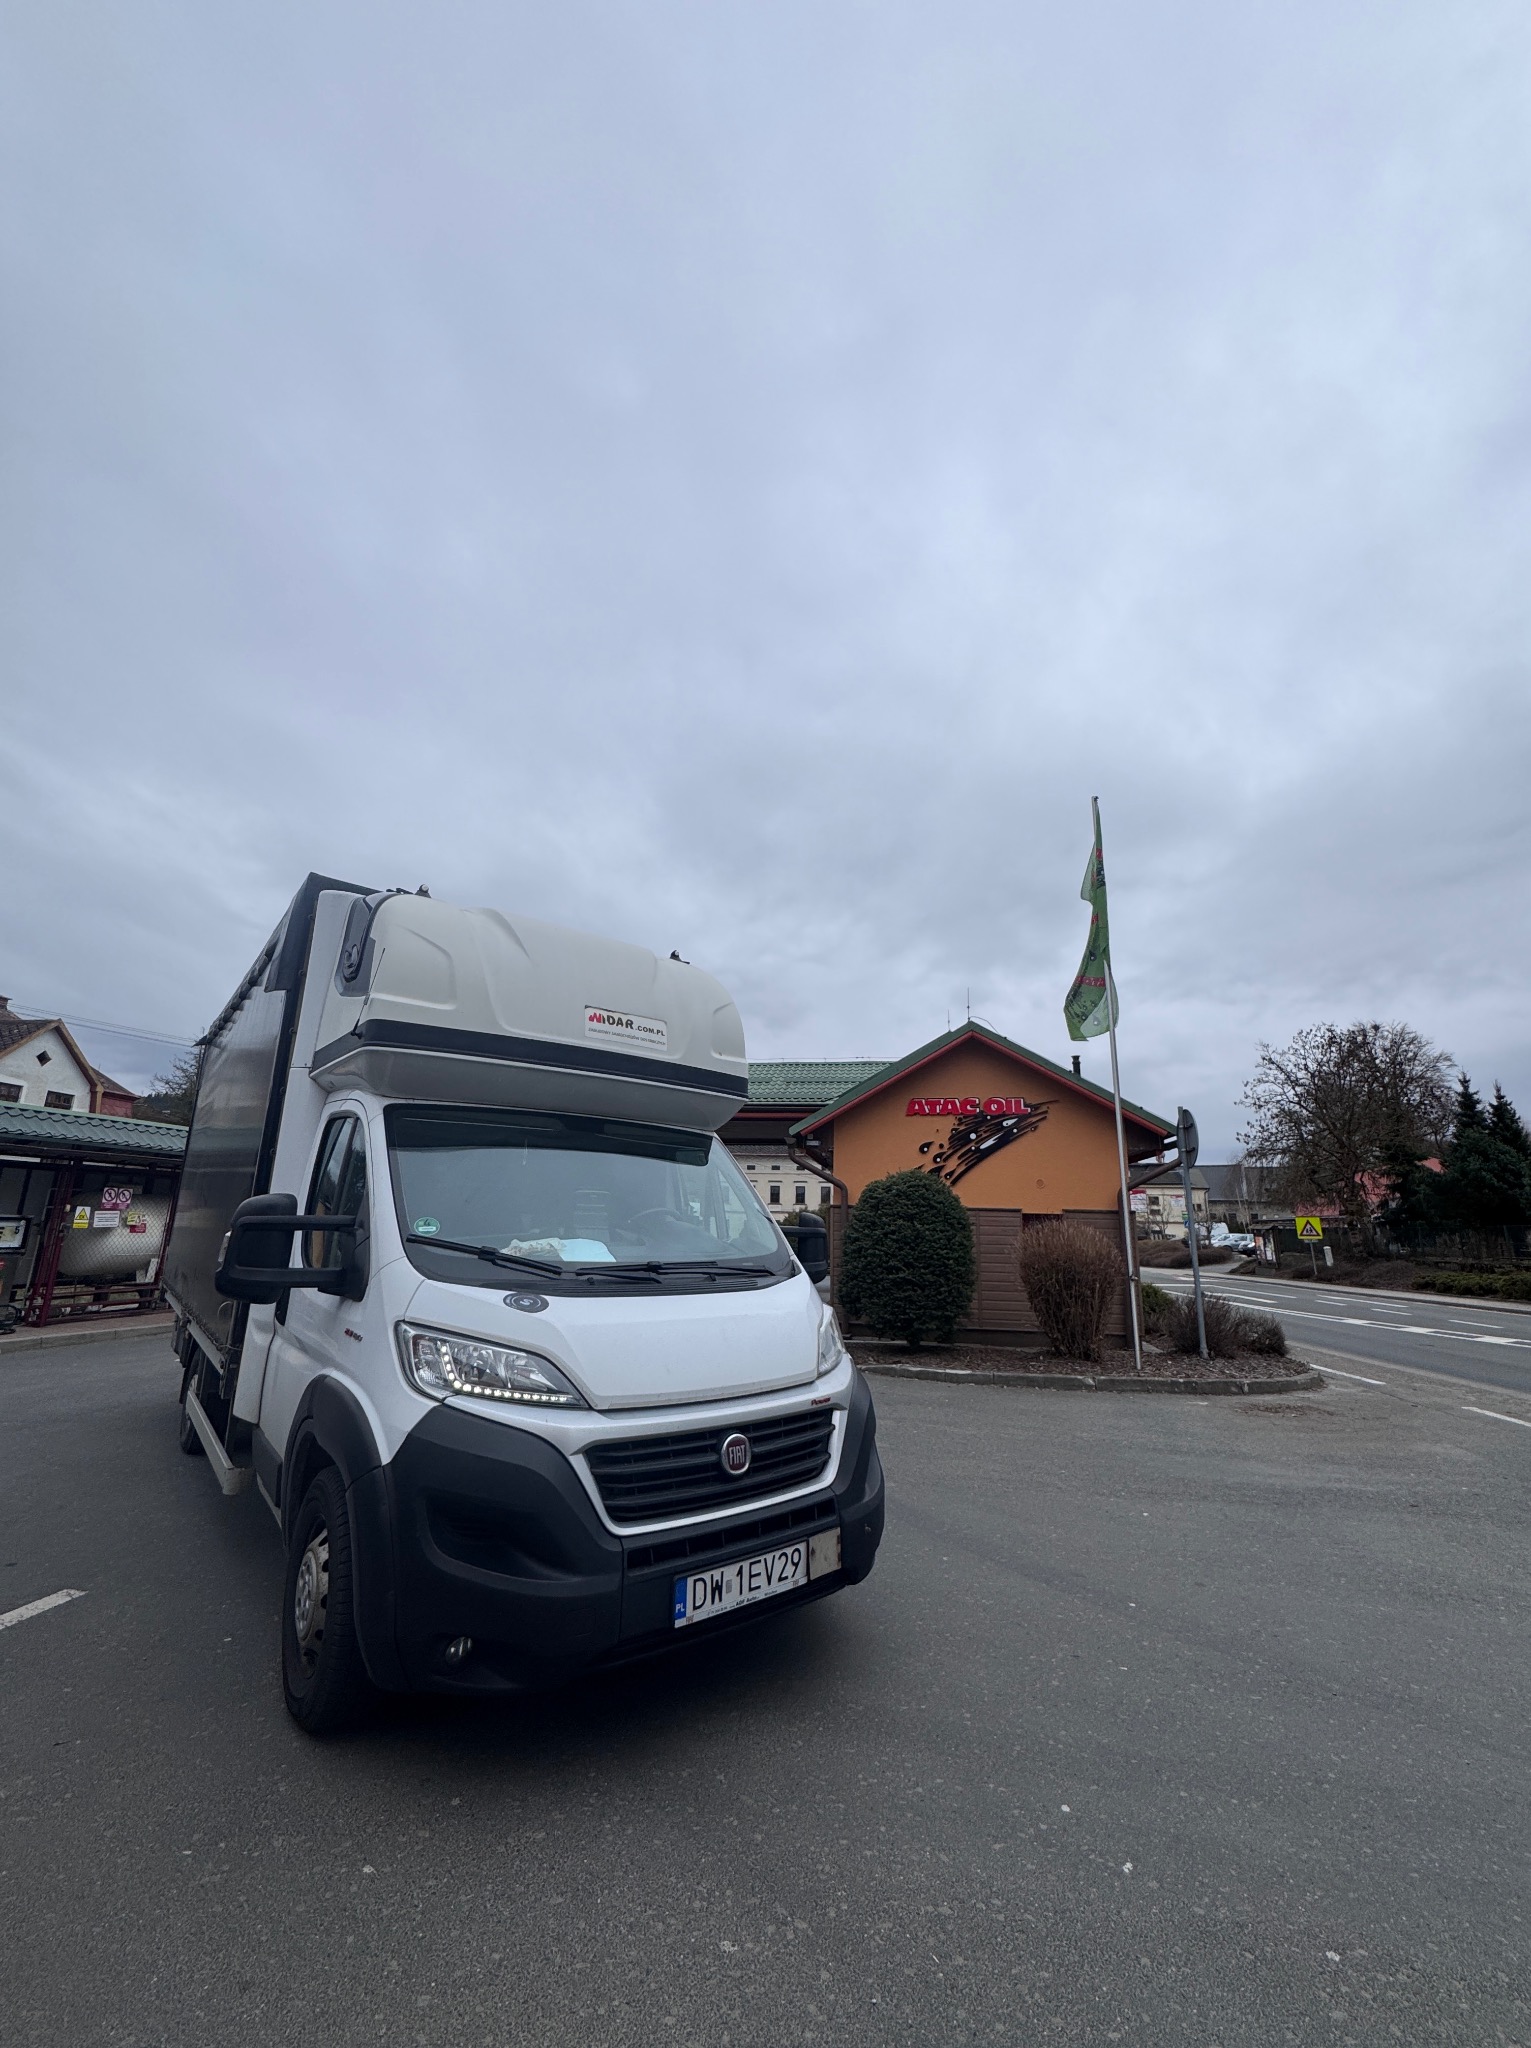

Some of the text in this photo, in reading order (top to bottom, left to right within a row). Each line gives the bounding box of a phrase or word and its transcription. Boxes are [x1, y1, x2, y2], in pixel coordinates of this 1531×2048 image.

[906, 1097, 1031, 1116] ATAC OIL
[729, 1444, 746, 1465] FIAT
[692, 1547, 802, 1611] DW 1EV29
[675, 1603, 685, 1614] PL
